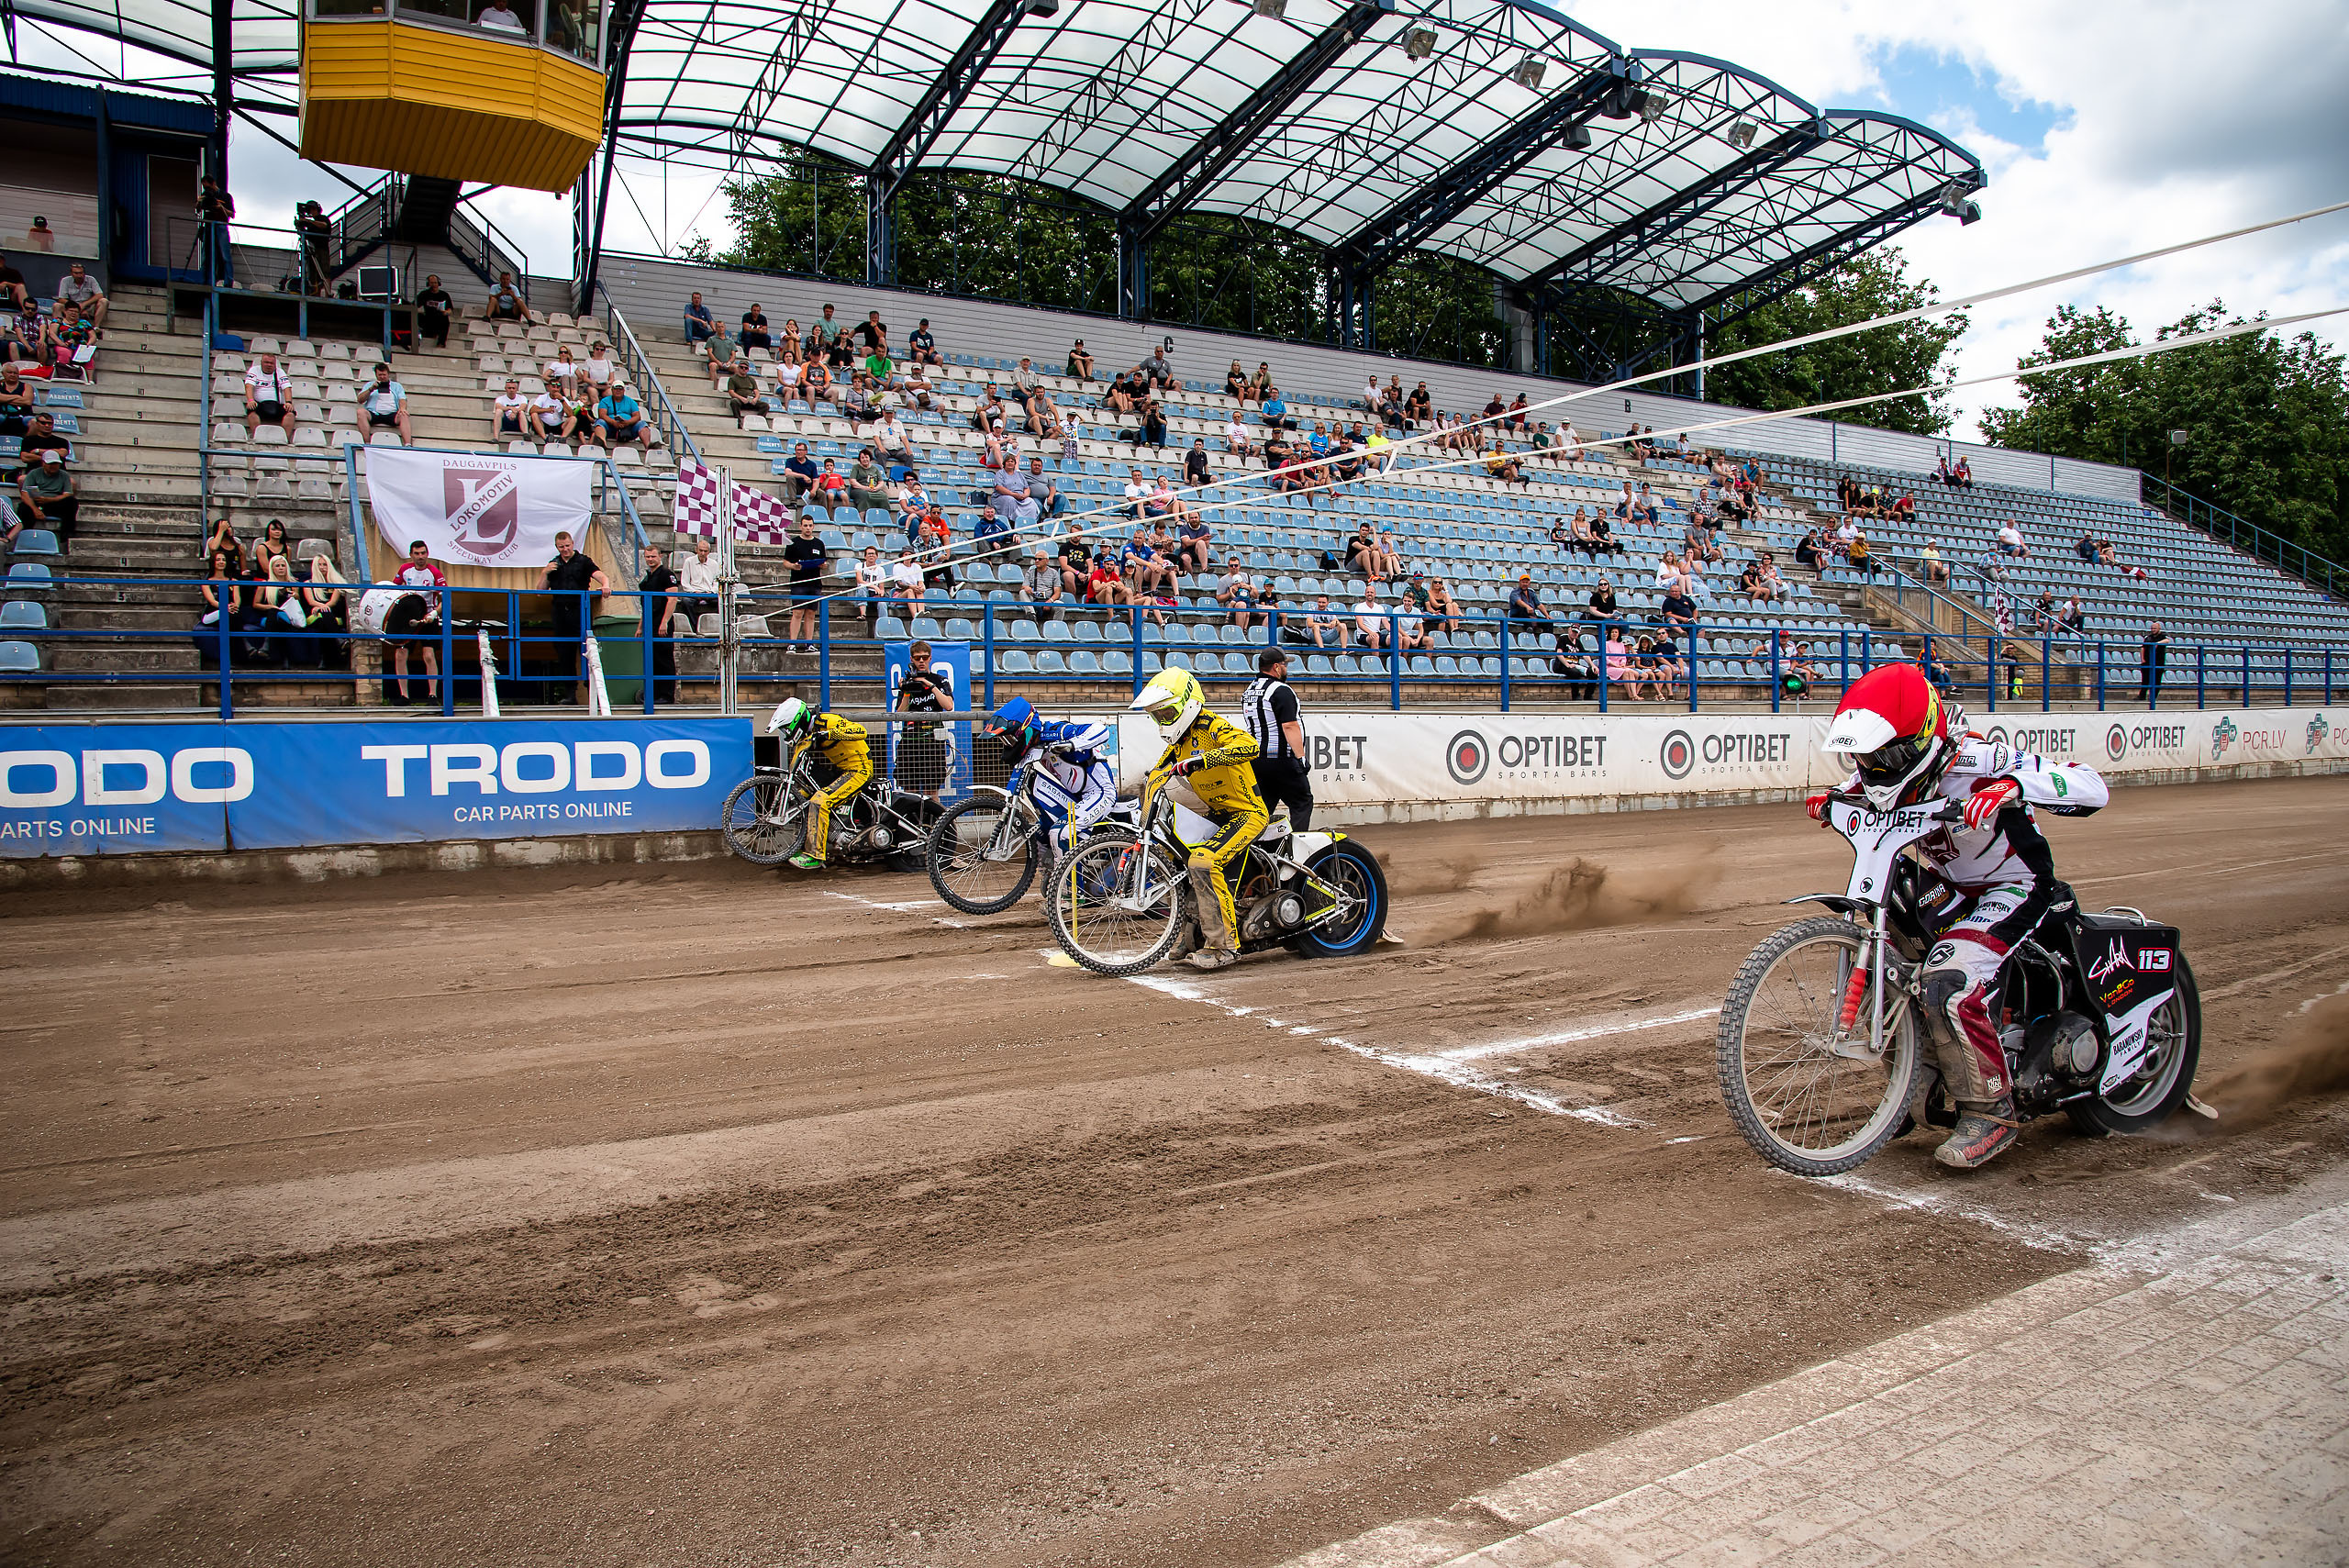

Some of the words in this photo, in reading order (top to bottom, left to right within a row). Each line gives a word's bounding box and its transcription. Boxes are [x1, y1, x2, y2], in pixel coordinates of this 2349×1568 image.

[1163, 336, 1174, 353] C
[1624, 399, 1631, 413] B
[133, 464, 138, 473] 7
[443, 459, 517, 470] DAUGAVPILS
[450, 474, 514, 532] LOKOMOTIV
[126, 524, 131, 532] 5
[121, 558, 127, 566] 4
[448, 540, 492, 564] SPEEDWAY
[498, 542, 519, 561] CLUB
[118, 593, 124, 601] 3
[2014, 728, 2076, 753] OPTIBET
[2131, 726, 2186, 750] OPTIBET
[2243, 729, 2287, 751] PCR.LV
[1305, 736, 1367, 770] IBET
[1498, 736, 1607, 768] OPTIBET
[1702, 734, 1790, 764] OPTIBET
[362, 739, 711, 797] TRODO
[1322, 773, 1366, 783] BĀRS
[1498, 771, 1560, 779] SPORTA
[1570, 769, 1607, 778] BĀRS
[1702, 765, 1752, 774] SPORTA
[1041, 781, 1068, 803] SAGARI
[453, 806, 495, 823] CAR
[499, 804, 561, 821] PARTS
[565, 801, 633, 818] ONLINE
[1083, 798, 1109, 825] SAGAR
[1865, 810, 1926, 828] OPTIBET
[70, 817, 155, 837] ONLINE
[2139, 950, 2171, 970] 113
[2107, 988, 2133, 1008] LONDON
[2120, 1041, 2141, 1058] FAMILY
